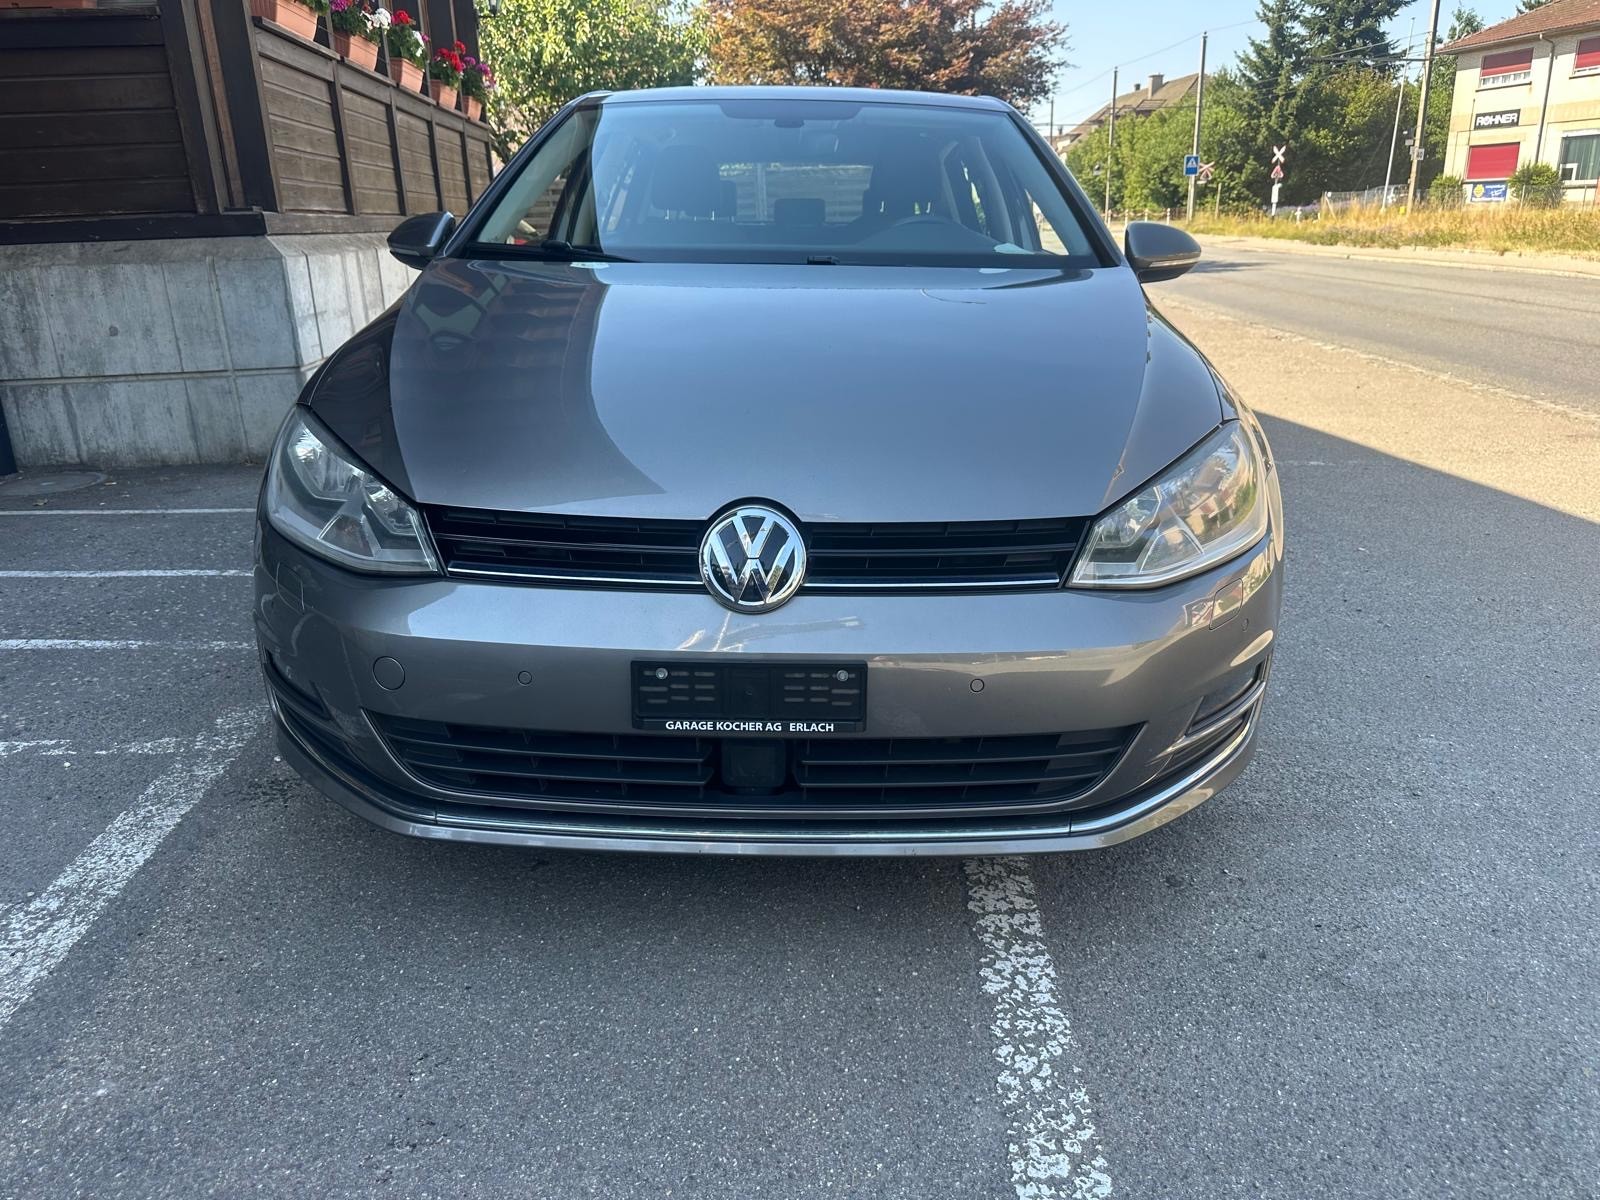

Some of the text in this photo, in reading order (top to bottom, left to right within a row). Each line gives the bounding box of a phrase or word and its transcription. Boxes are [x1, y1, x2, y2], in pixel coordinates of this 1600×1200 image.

[1476, 113, 1518, 126] ROHNER
[702, 507, 804, 609] VW
[665, 720, 834, 733] GARAGE KOCHER AG ERLACH
